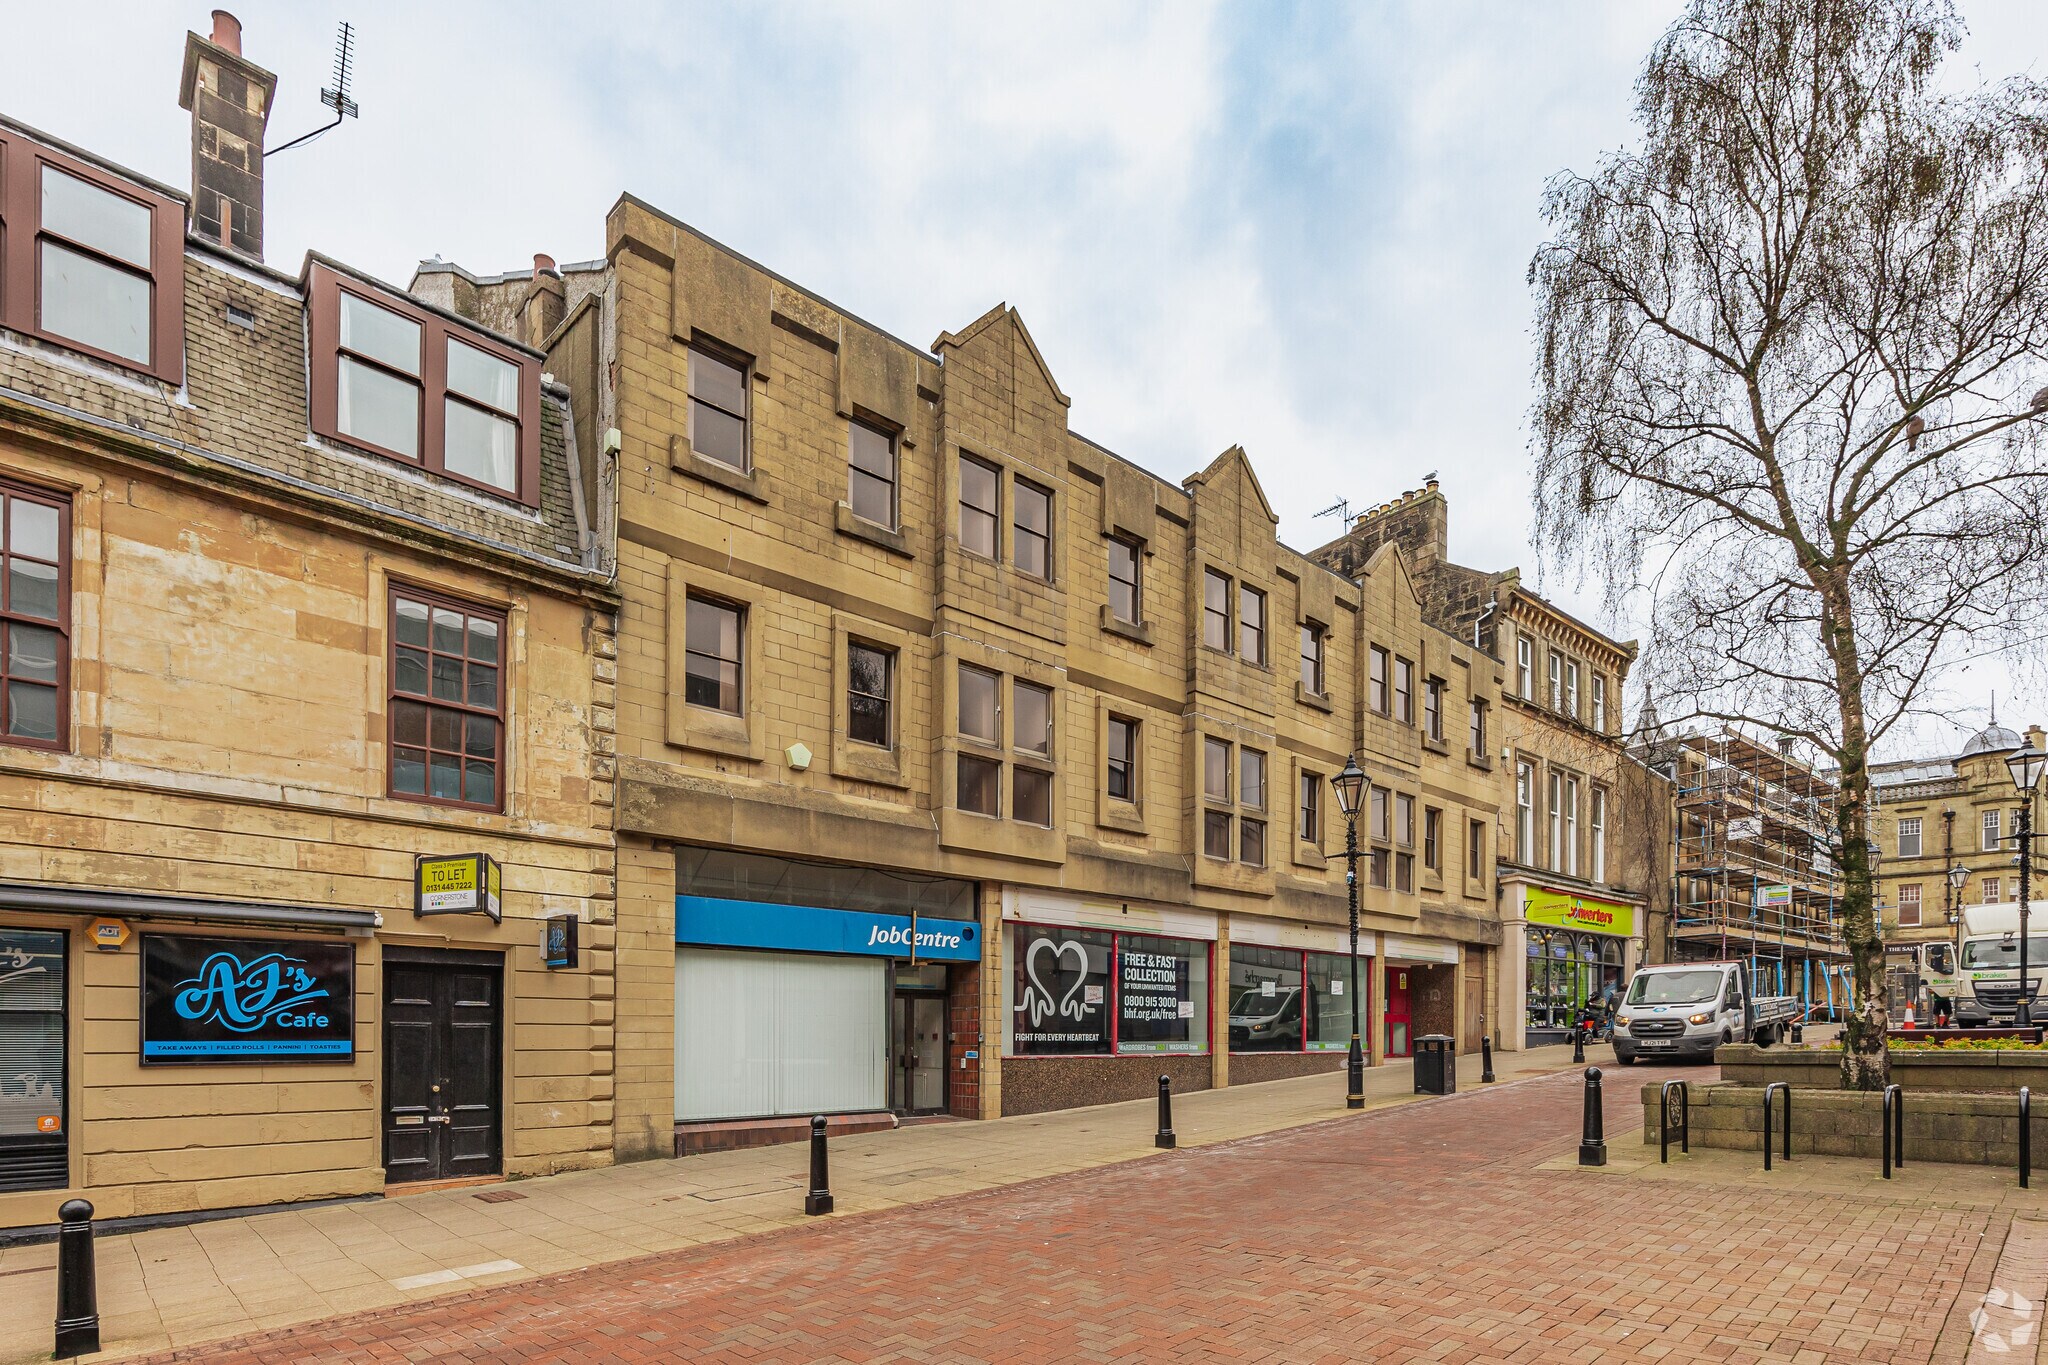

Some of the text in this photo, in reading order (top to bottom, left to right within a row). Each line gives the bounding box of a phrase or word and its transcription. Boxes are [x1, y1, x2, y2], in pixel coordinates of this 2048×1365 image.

[432, 868, 466, 882] TO LET
[456, 882, 472, 890] 7222
[430, 893, 468, 901] CORNERSTONE
[98, 928, 120, 936] ADT
[868, 926, 960, 948] JobCentre
[1124, 953, 1176, 968] FREE & FAST
[1124, 968, 1176, 983] COLLECTION
[174, 961, 317, 1023] AJ's
[1124, 996, 1176, 1008] 0800 915 3000
[276, 1012, 329, 1028] Cafe
[1124, 1008, 1176, 1021] bhf.org.uk/free
[1015, 1032, 1100, 1042] FIGHT FOR EVERY HEARTBEAT
